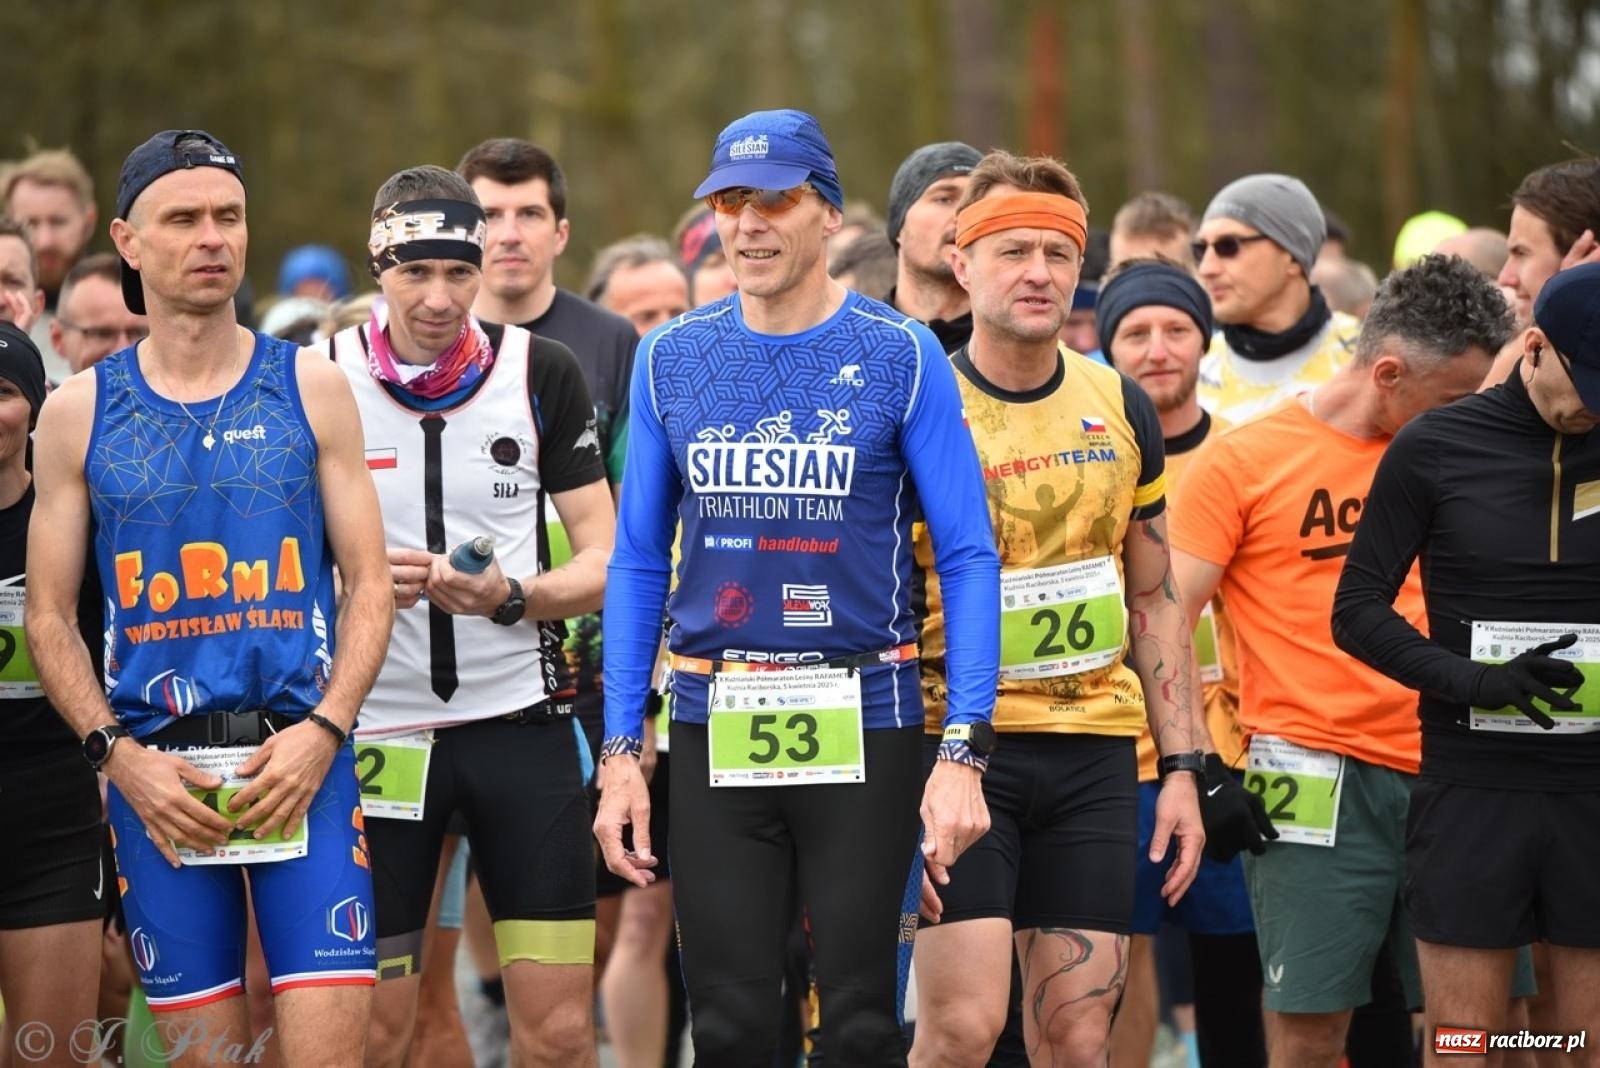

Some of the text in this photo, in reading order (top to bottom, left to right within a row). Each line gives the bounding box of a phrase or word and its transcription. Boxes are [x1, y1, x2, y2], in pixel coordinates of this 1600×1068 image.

[731, 143, 767, 154] SILESIAN
[223, 424, 266, 442] quest
[692, 447, 849, 491] SILESIAN
[699, 496, 844, 521] TRIATHLON TEAM
[720, 538, 752, 550] PROFI
[758, 535, 839, 553] handlobud
[124, 604, 305, 645] WODZISŁAW ŚLĄSKI
[1030, 602, 1095, 658] 26
[748, 712, 820, 764] 53
